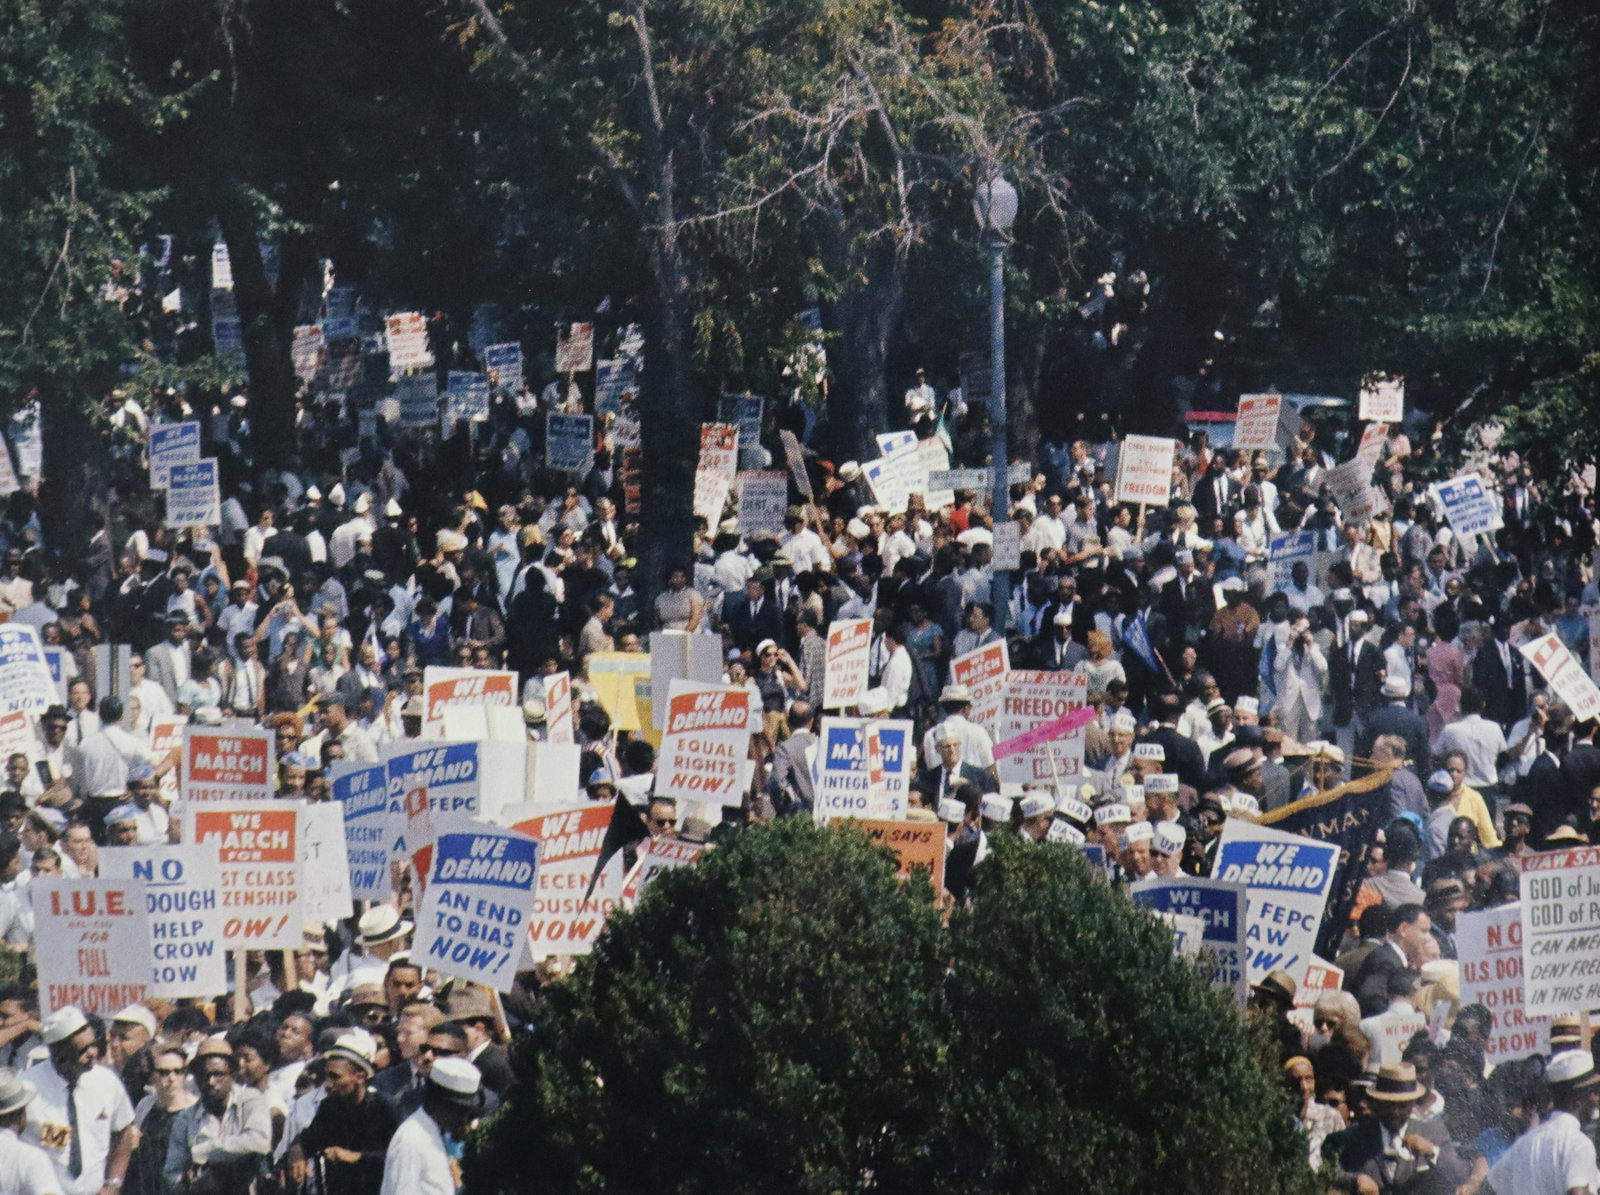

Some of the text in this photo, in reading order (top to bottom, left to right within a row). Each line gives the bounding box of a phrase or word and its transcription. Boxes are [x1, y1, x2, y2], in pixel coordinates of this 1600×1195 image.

[1124, 482, 1167, 496] FREEDOM
[453, 676, 488, 695] WE
[832, 682, 863, 700] NOW!
[972, 681, 1002, 700] OBS
[695, 692, 726, 711] WE
[1004, 697, 1083, 717] FREEDOM
[672, 708, 746, 731] DEMAND
[217, 739, 242, 753] WE
[677, 738, 736, 758] EQUAL
[195, 753, 263, 772] MARCH
[413, 749, 448, 769] WE
[674, 755, 736, 775] RIGHTS
[215, 772, 244, 782] FOR
[350, 771, 371, 794] WE
[671, 773, 736, 794] NOW!
[824, 776, 901, 791] INTEGRED
[345, 787, 386, 813] EMAND
[430, 797, 477, 813] FEPC
[230, 813, 262, 830] WE
[541, 811, 583, 839] WE
[202, 829, 289, 850] MARCH
[891, 829, 932, 843] SAYS
[227, 850, 263, 862] FOR
[348, 849, 387, 866] OUSING
[470, 836, 510, 858] WE
[1256, 843, 1300, 865] WE
[132, 859, 183, 881] NO
[440, 858, 532, 884] DEMAND
[1526, 850, 1600, 871] UAW SA
[220, 870, 296, 888] ST CLASS
[353, 869, 384, 889] OW!
[540, 872, 608, 890] ECENT
[1222, 863, 1324, 889] DEMAND
[221, 889, 298, 906] ZENSHIP
[1169, 889, 1201, 905] WE
[1530, 874, 1600, 900] GOD of Ju
[50, 889, 134, 917] I.U.E.
[438, 890, 522, 927] AN END
[532, 897, 615, 915] OUSING
[1167, 907, 1230, 928] ARCH
[1260, 902, 1316, 932] FEPC
[1531, 902, 1563, 927] GOD
[1569, 902, 1584, 924] of
[153, 920, 204, 939] HELP
[222, 914, 289, 939] OW!
[436, 912, 516, 949] TO BIAS
[528, 919, 595, 942] NOW
[1246, 924, 1290, 947] AW
[1486, 920, 1523, 948] NO
[79, 931, 110, 944] FOR
[1530, 933, 1600, 956] CAN AMER
[153, 940, 215, 960] CROW
[430, 935, 512, 974] NOW!
[77, 948, 111, 978] FULL
[1464, 960, 1493, 984] U.S.
[1530, 958, 1600, 981] DENY FREE
[48, 983, 148, 1014] EMPLOYMENT
[1476, 986, 1525, 1008] TO HE
[1530, 988, 1548, 1005] IN
[1551, 983, 1584, 1002] THIS
[1485, 1031, 1537, 1056] GROW
